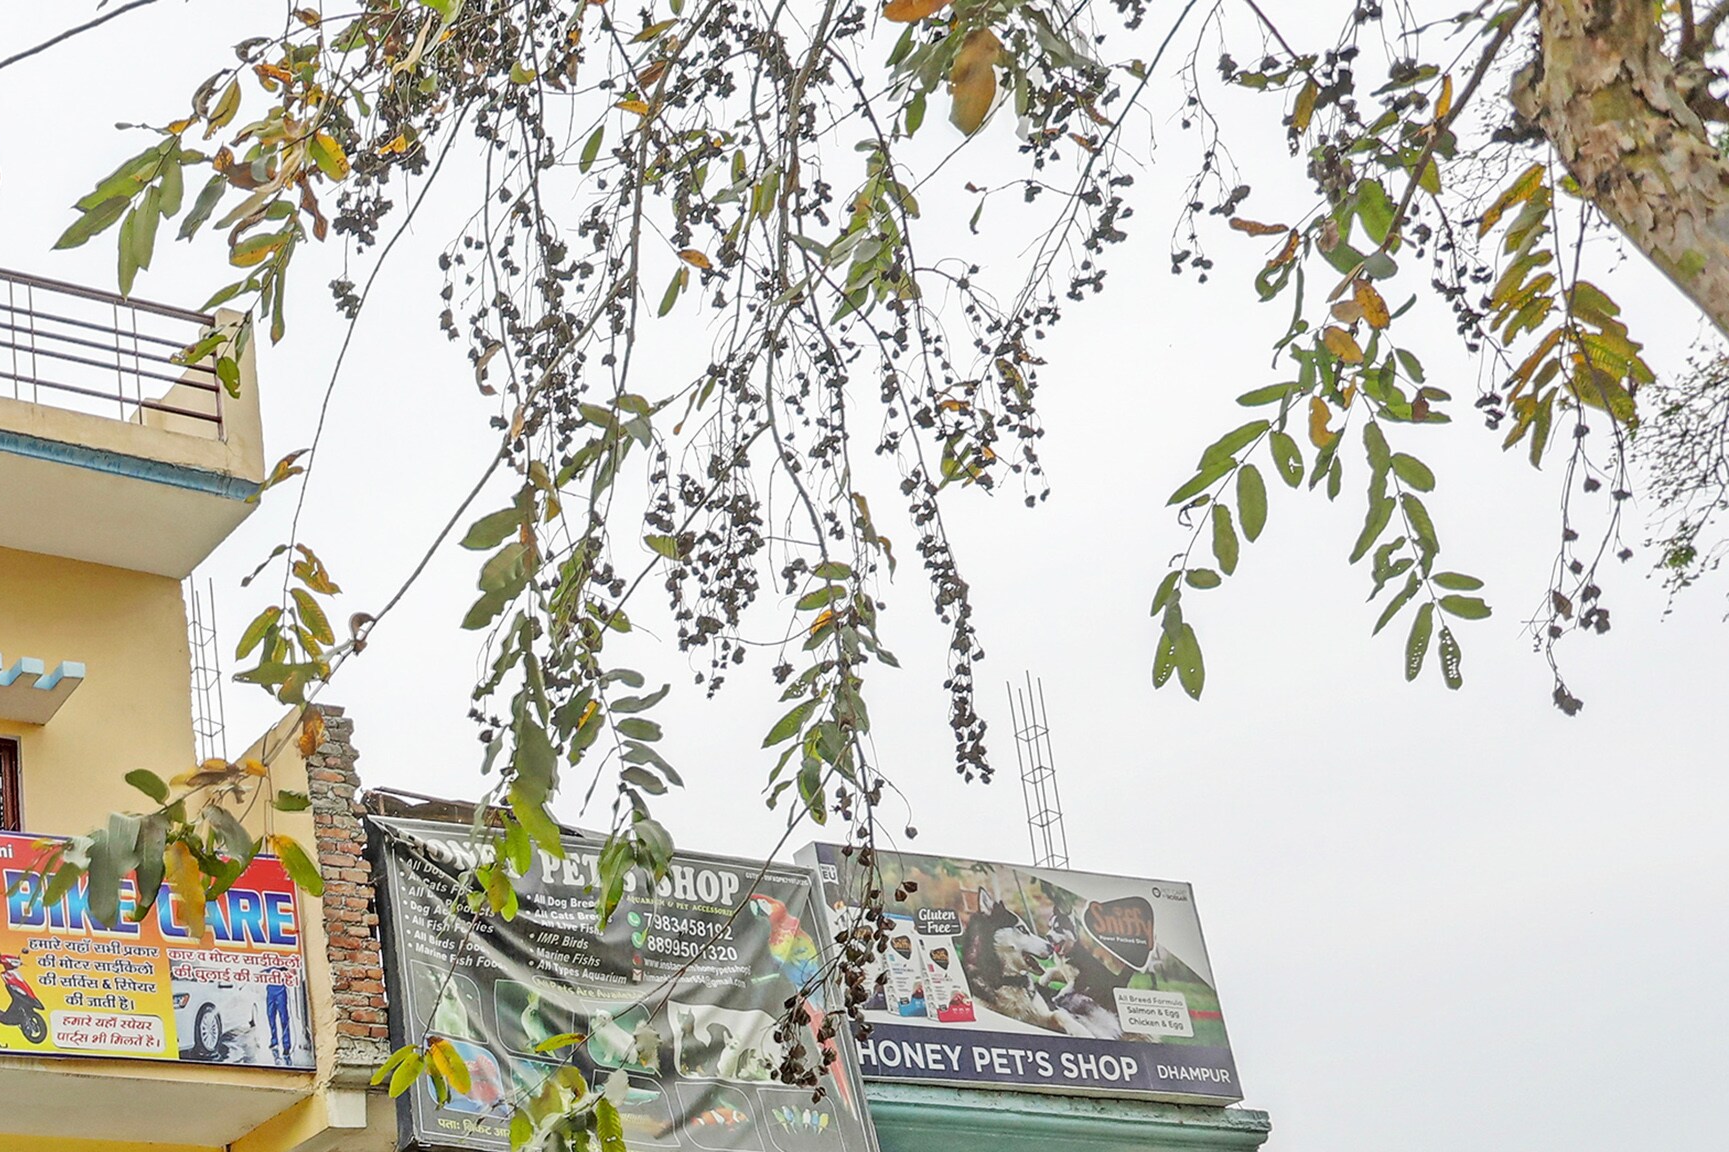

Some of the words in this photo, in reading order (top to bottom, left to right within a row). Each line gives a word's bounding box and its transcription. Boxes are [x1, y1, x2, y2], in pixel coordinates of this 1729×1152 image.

[823, 870, 836, 881] EU
[409, 887, 424, 897] All
[534, 894, 546, 905] All
[548, 898, 567, 909] Dog
[676, 902, 689, 911] PET
[410, 902, 430, 916] Dog
[534, 910, 548, 918] All
[551, 912, 575, 920] Cats
[918, 909, 955, 921] Gluten
[412, 915, 424, 926] All
[427, 919, 450, 932] Fish
[927, 922, 951, 933] Free
[1090, 902, 1154, 950] Sniffy
[414, 931, 427, 942] All
[429, 935, 455, 949] Birds
[562, 936, 589, 949] Birds
[29, 938, 61, 950] हमारे
[94, 941, 120, 954] सभी
[124, 946, 159, 958] प्रकार
[415, 943, 447, 960] Marine
[450, 955, 473, 967] Fish
[38, 954, 55, 967] की
[60, 956, 90, 969] मोटर
[168, 950, 194, 959] कार
[209, 950, 239, 963] मोटर
[536, 948, 570, 962] Marine
[572, 953, 601, 967] Fishs
[174, 965, 191, 977] की
[233, 969, 250, 981] की
[554, 962, 579, 977] Types
[582, 970, 627, 985] Aquarium
[39, 973, 56, 986] की
[103, 979, 112, 989] &
[65, 993, 83, 1006] की
[87, 995, 116, 1008] जाती
[1130, 995, 1152, 1004] Breed
[1153, 996, 1183, 1006] Formula
[1127, 1006, 1156, 1016] Salmon
[1158, 1008, 1163, 1016] &
[1165, 1007, 1180, 1019] Egg
[62, 1016, 92, 1026] हमारे
[1129, 1017, 1159, 1027] Chicken
[1162, 1019, 1167, 1027] &
[1169, 1019, 1184, 1030] Egg
[92, 1032, 108, 1043] भी
[857, 1039, 962, 1072] HONEY
[971, 1046, 1054, 1078] PET'S
[1061, 1051, 1138, 1082] SHOP
[1157, 1064, 1231, 1085] DHAMPUR
